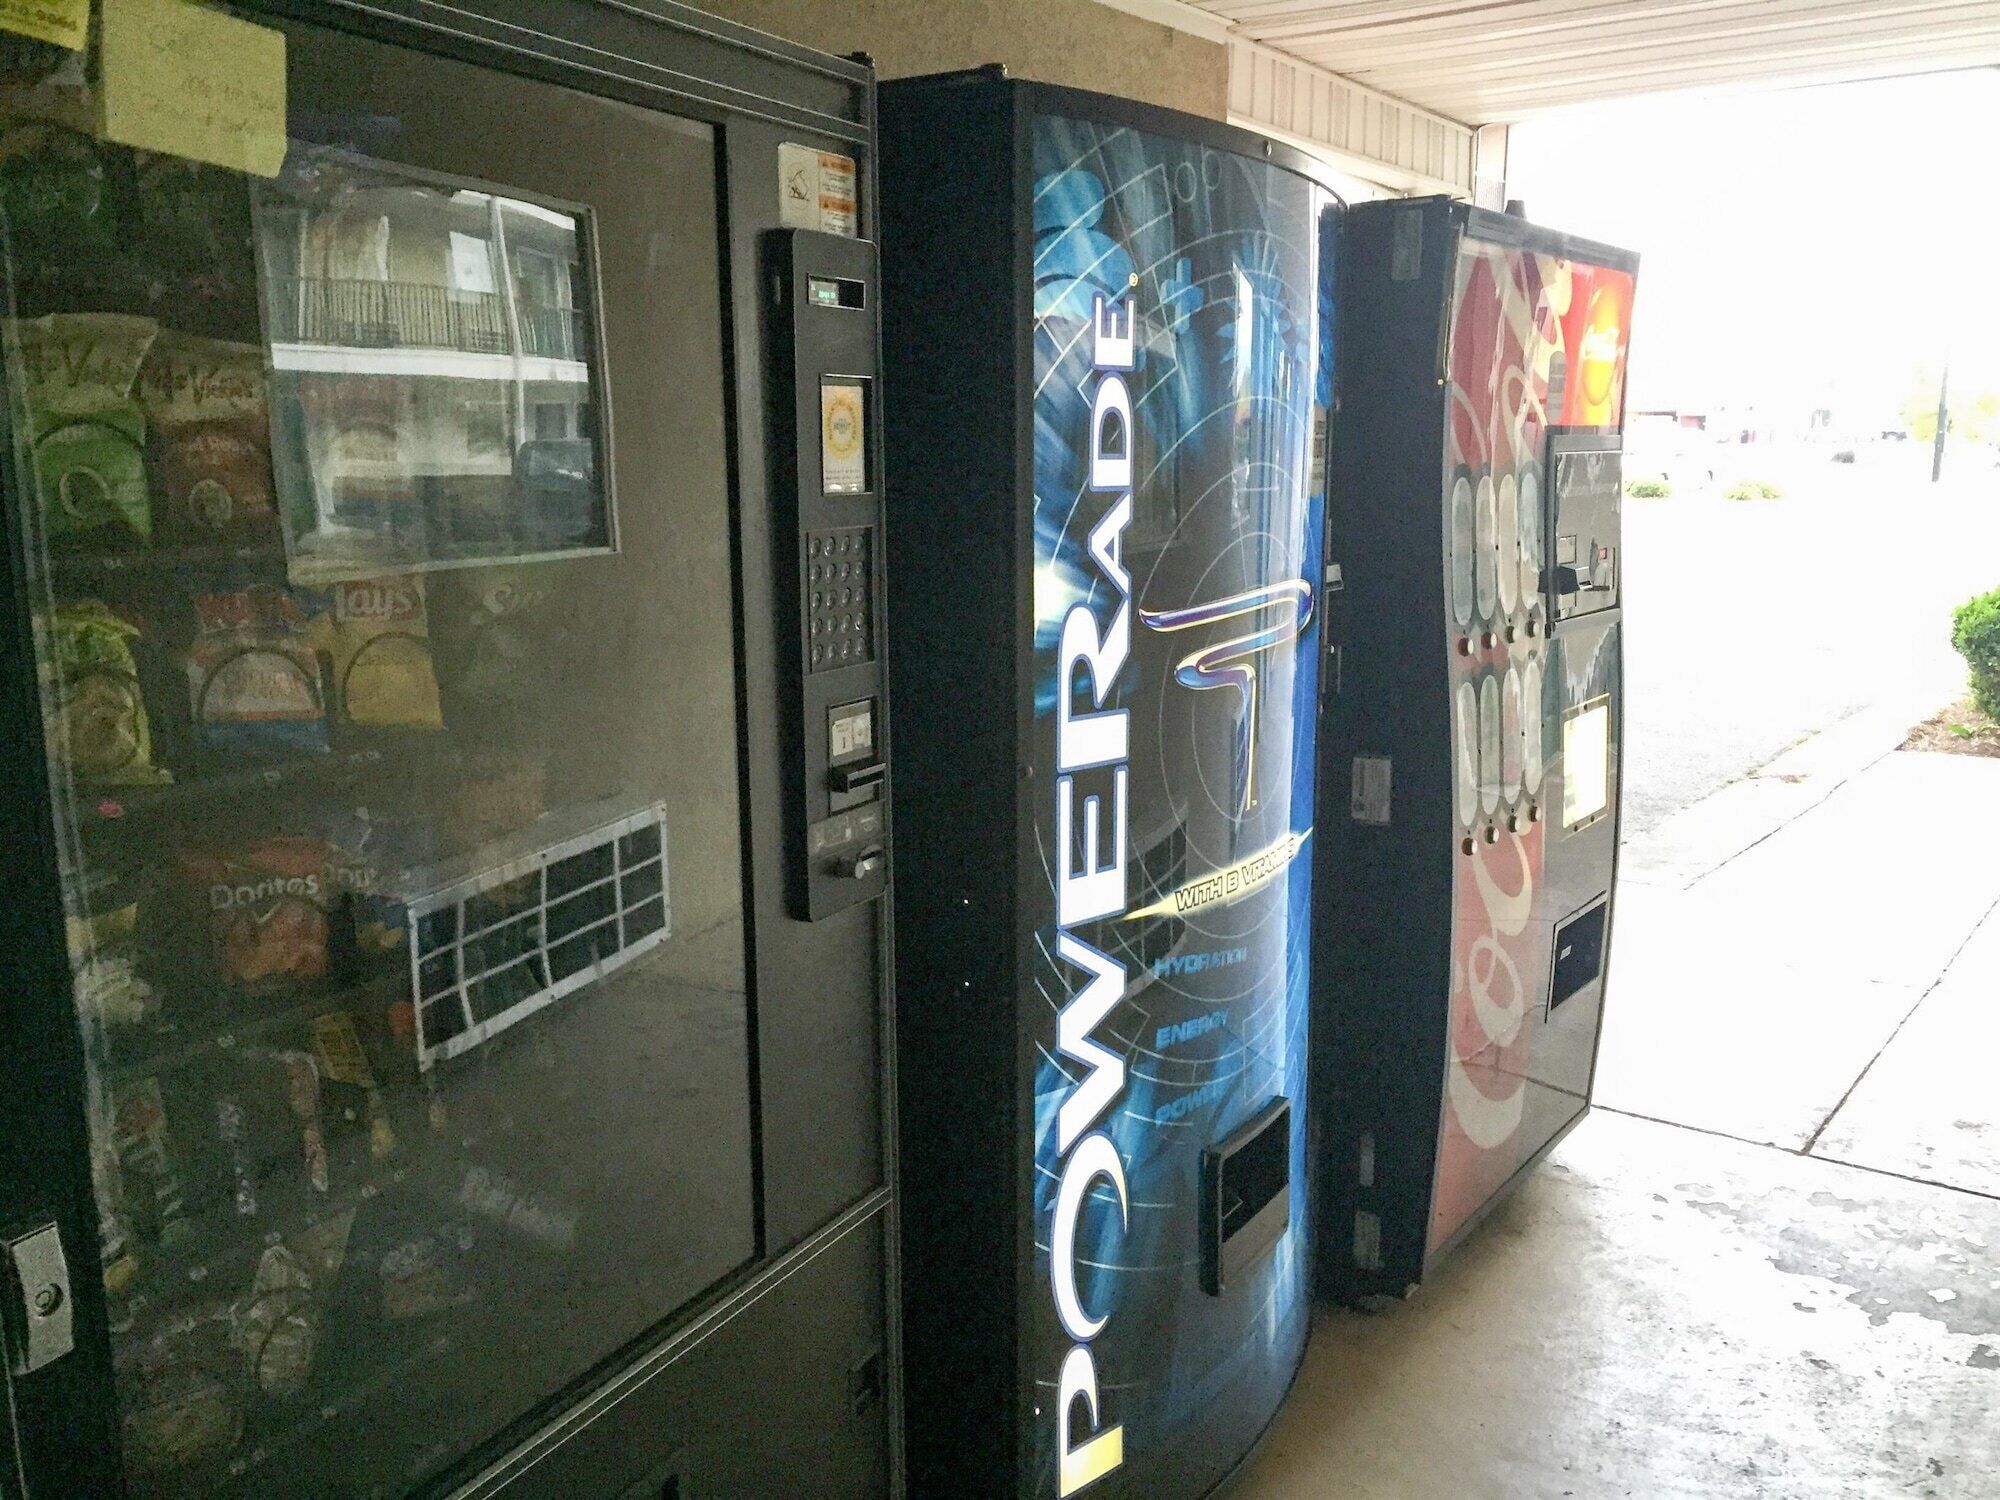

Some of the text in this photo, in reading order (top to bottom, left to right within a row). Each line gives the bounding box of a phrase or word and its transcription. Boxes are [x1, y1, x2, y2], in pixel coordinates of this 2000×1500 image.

[209, 873, 320, 910] Doritos
[1052, 291, 1137, 1498] POWERADE
[1174, 876, 1222, 912] WITH
[1226, 870, 1239, 894] B
[1153, 947, 1248, 978] HYDRATION
[1155, 1009, 1229, 1049] ENERGY
